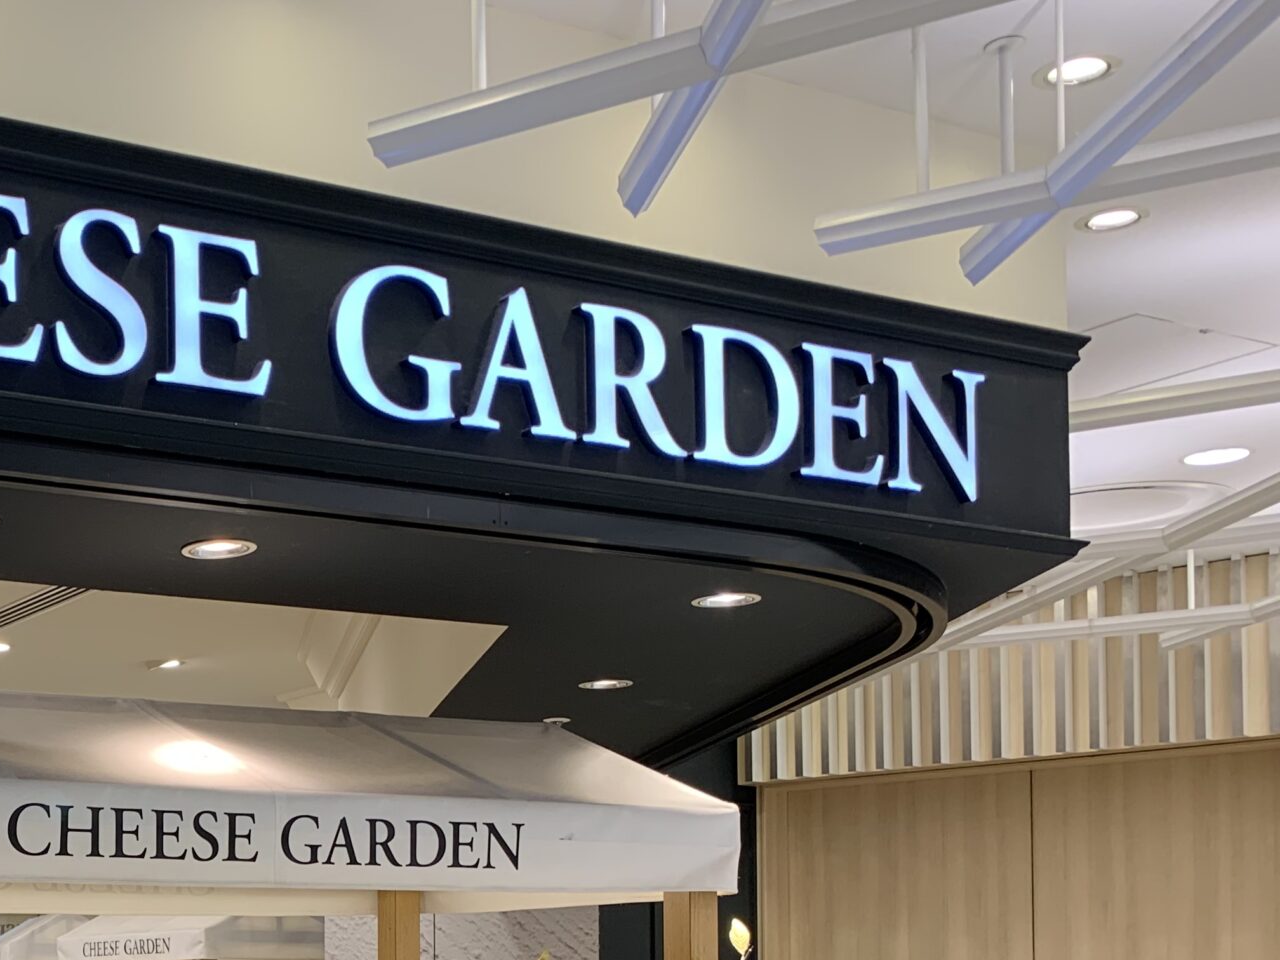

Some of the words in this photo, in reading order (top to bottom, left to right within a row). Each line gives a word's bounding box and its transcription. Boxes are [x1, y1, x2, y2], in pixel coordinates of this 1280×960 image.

[333, 264, 986, 503] GARDEN
[6, 801, 260, 863] CHEESE
[279, 813, 526, 871] GARDEN
[82, 940, 121, 958] CHEESE
[123, 936, 172, 956] GARDEN
